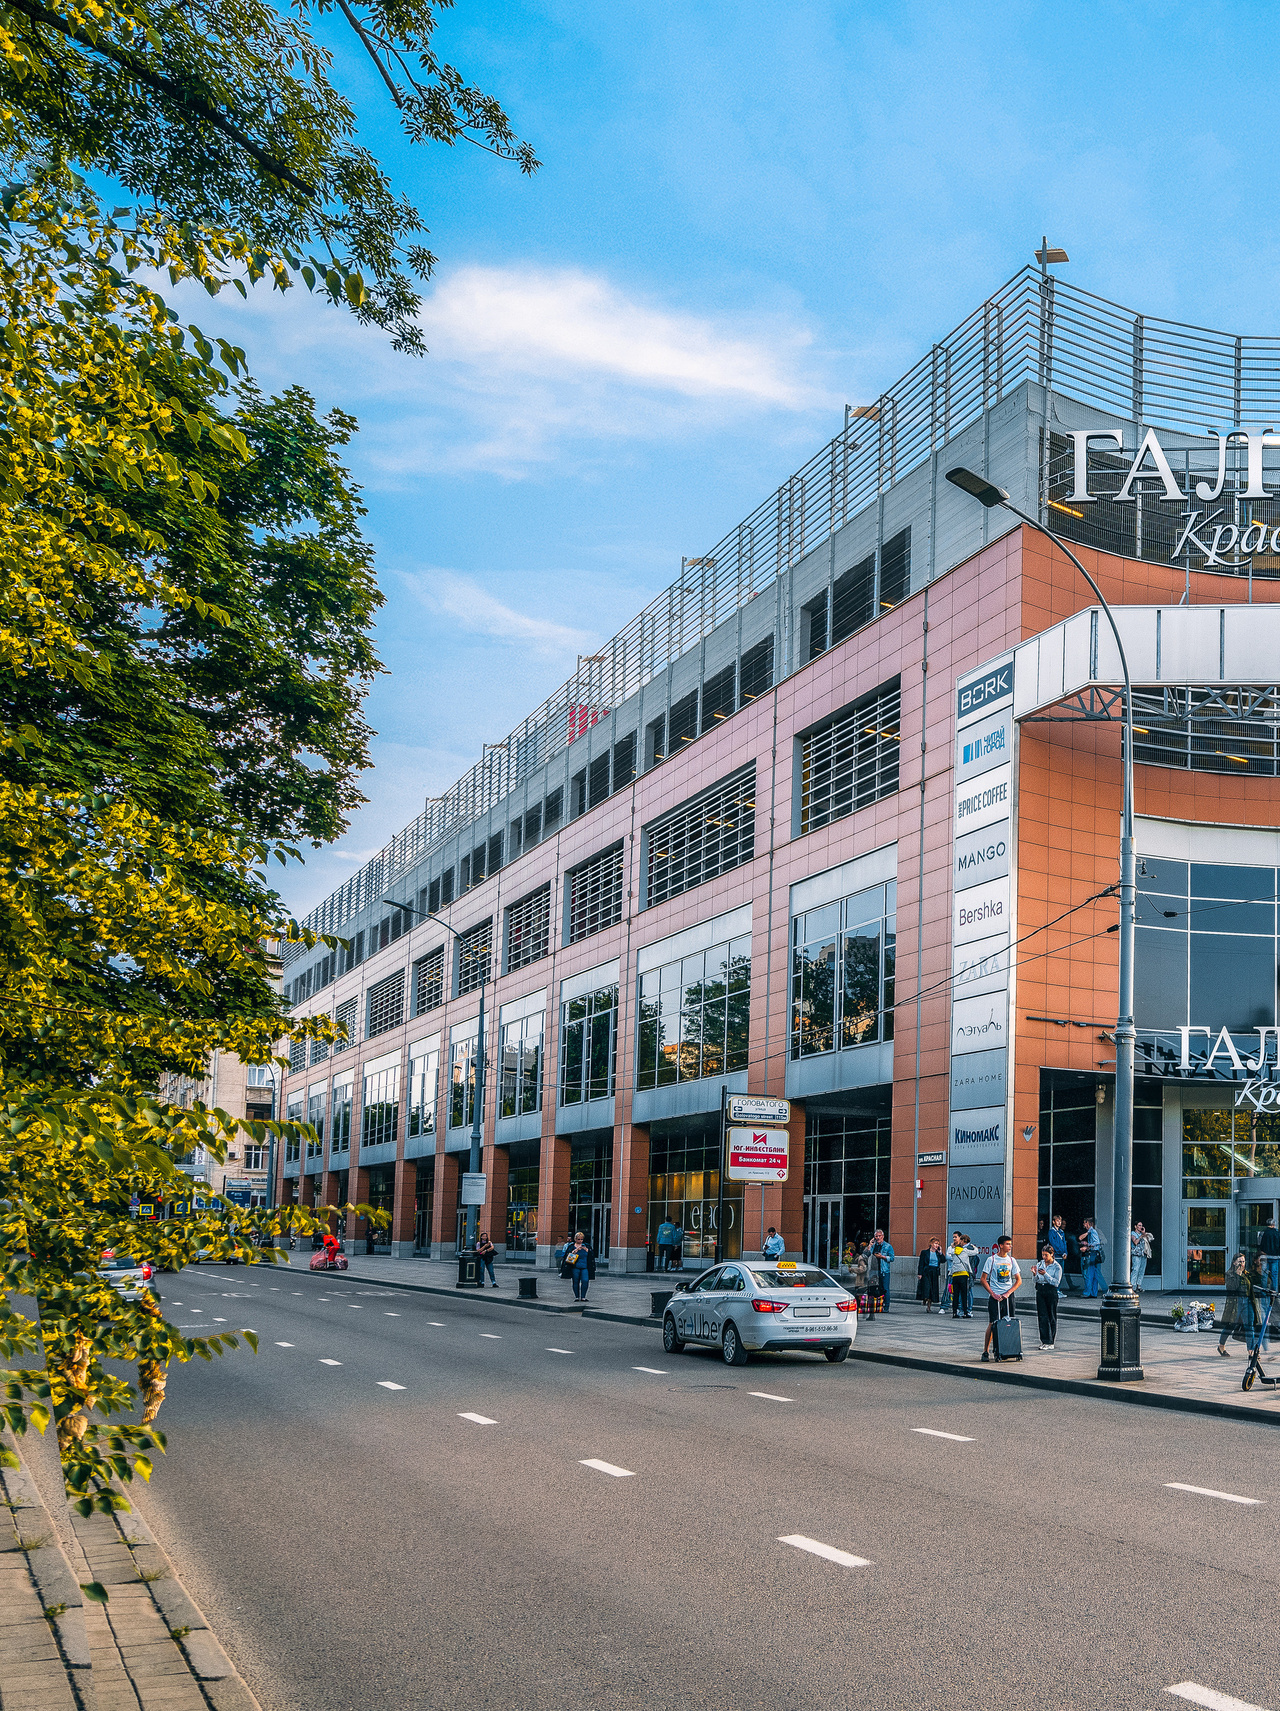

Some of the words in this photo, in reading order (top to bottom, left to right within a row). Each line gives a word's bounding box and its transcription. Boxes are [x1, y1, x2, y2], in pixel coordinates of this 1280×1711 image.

[961, 670, 1009, 711] BORK
[984, 725, 1005, 743] ЧИТАЙ
[984, 738, 1006, 755] ГОРОД
[962, 793, 982, 817] PRICE
[983, 782, 1008, 808] COFFEE
[958, 841, 1006, 871] MANGO
[959, 901, 1003, 926] Bershka
[958, 956, 999, 982] ZARA
[955, 1077, 975, 1087] ZARA
[978, 1073, 1002, 1084] HOME
[738, 1099, 784, 1108] ГОЛОВАТОГО
[955, 1124, 999, 1144] КИНОМАКС
[950, 1181, 1000, 1200] PANDORA
[693, 1313, 722, 1341] Uber
